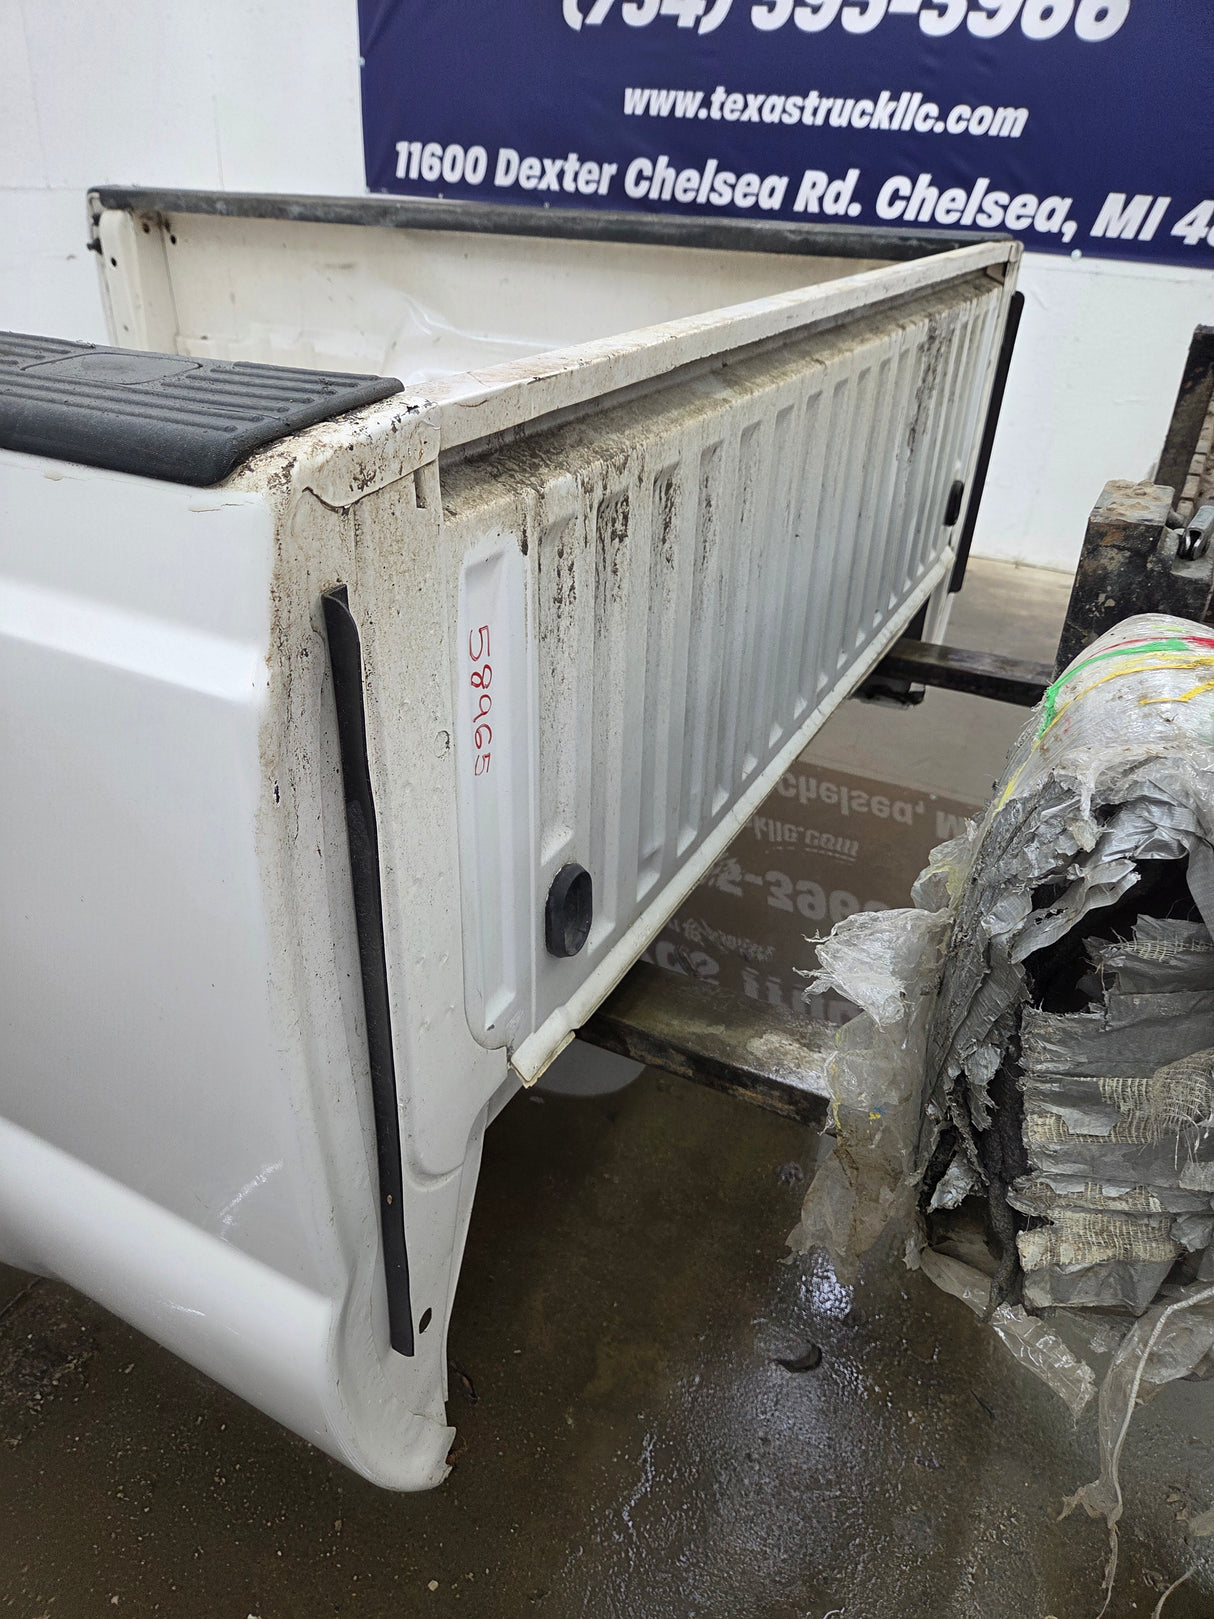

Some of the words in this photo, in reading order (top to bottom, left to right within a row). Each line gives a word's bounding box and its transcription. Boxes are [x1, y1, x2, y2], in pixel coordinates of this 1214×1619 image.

[624, 86, 1029, 138] www.texastruckllc.com
[395, 141, 488, 185] 11600
[495, 148, 618, 195] Dexter
[624, 156, 790, 210] Chelsea
[793, 169, 862, 217] Rd.
[875, 173, 1078, 243] Chelsea,
[1090, 192, 1172, 241] MI
[1170, 199, 1214, 247] 4
[469, 625, 493, 776] 58965
